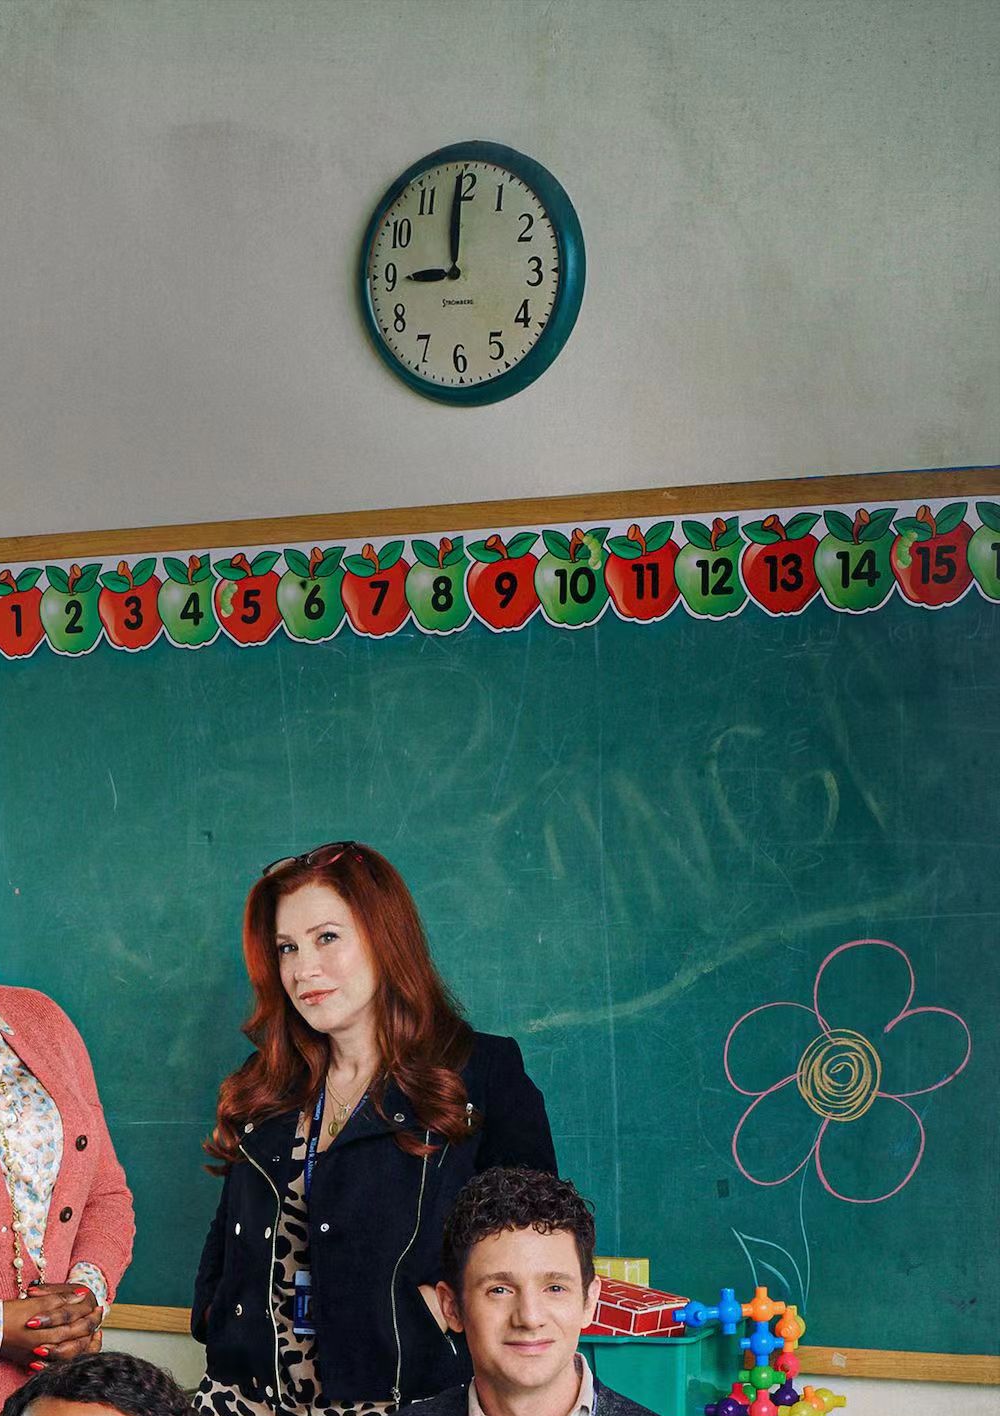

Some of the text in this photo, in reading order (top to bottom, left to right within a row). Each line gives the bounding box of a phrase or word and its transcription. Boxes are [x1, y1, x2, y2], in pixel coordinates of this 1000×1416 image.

[418, 186, 436, 215] 11
[495, 184, 503, 211] 1
[392, 218, 411, 248] 10
[517, 213, 533, 242] 2
[385, 263, 397, 292] 9
[526, 256, 543, 286] 3
[394, 304, 405, 332] 8
[515, 299, 531, 328] 4
[417, 334, 431, 362] 7
[453, 344, 467, 373] 6
[489, 331, 504, 360] 5
[11, 605, 21, 636] 1
[65, 600, 83, 633] 2
[125, 596, 142, 630] 3
[180, 593, 203, 626] 4
[242, 590, 260, 624] 5
[305, 584, 325, 620] 6
[370, 581, 389, 615] 7
[432, 576, 453, 612] 8
[496, 572, 517, 608] 9
[555, 567, 596, 604] 10
[632, 563, 658, 599] 11
[696, 558, 734, 596] 12
[765, 554, 803, 592] 13
[836, 549, 881, 588] 14
[916, 546, 956, 584] 15
